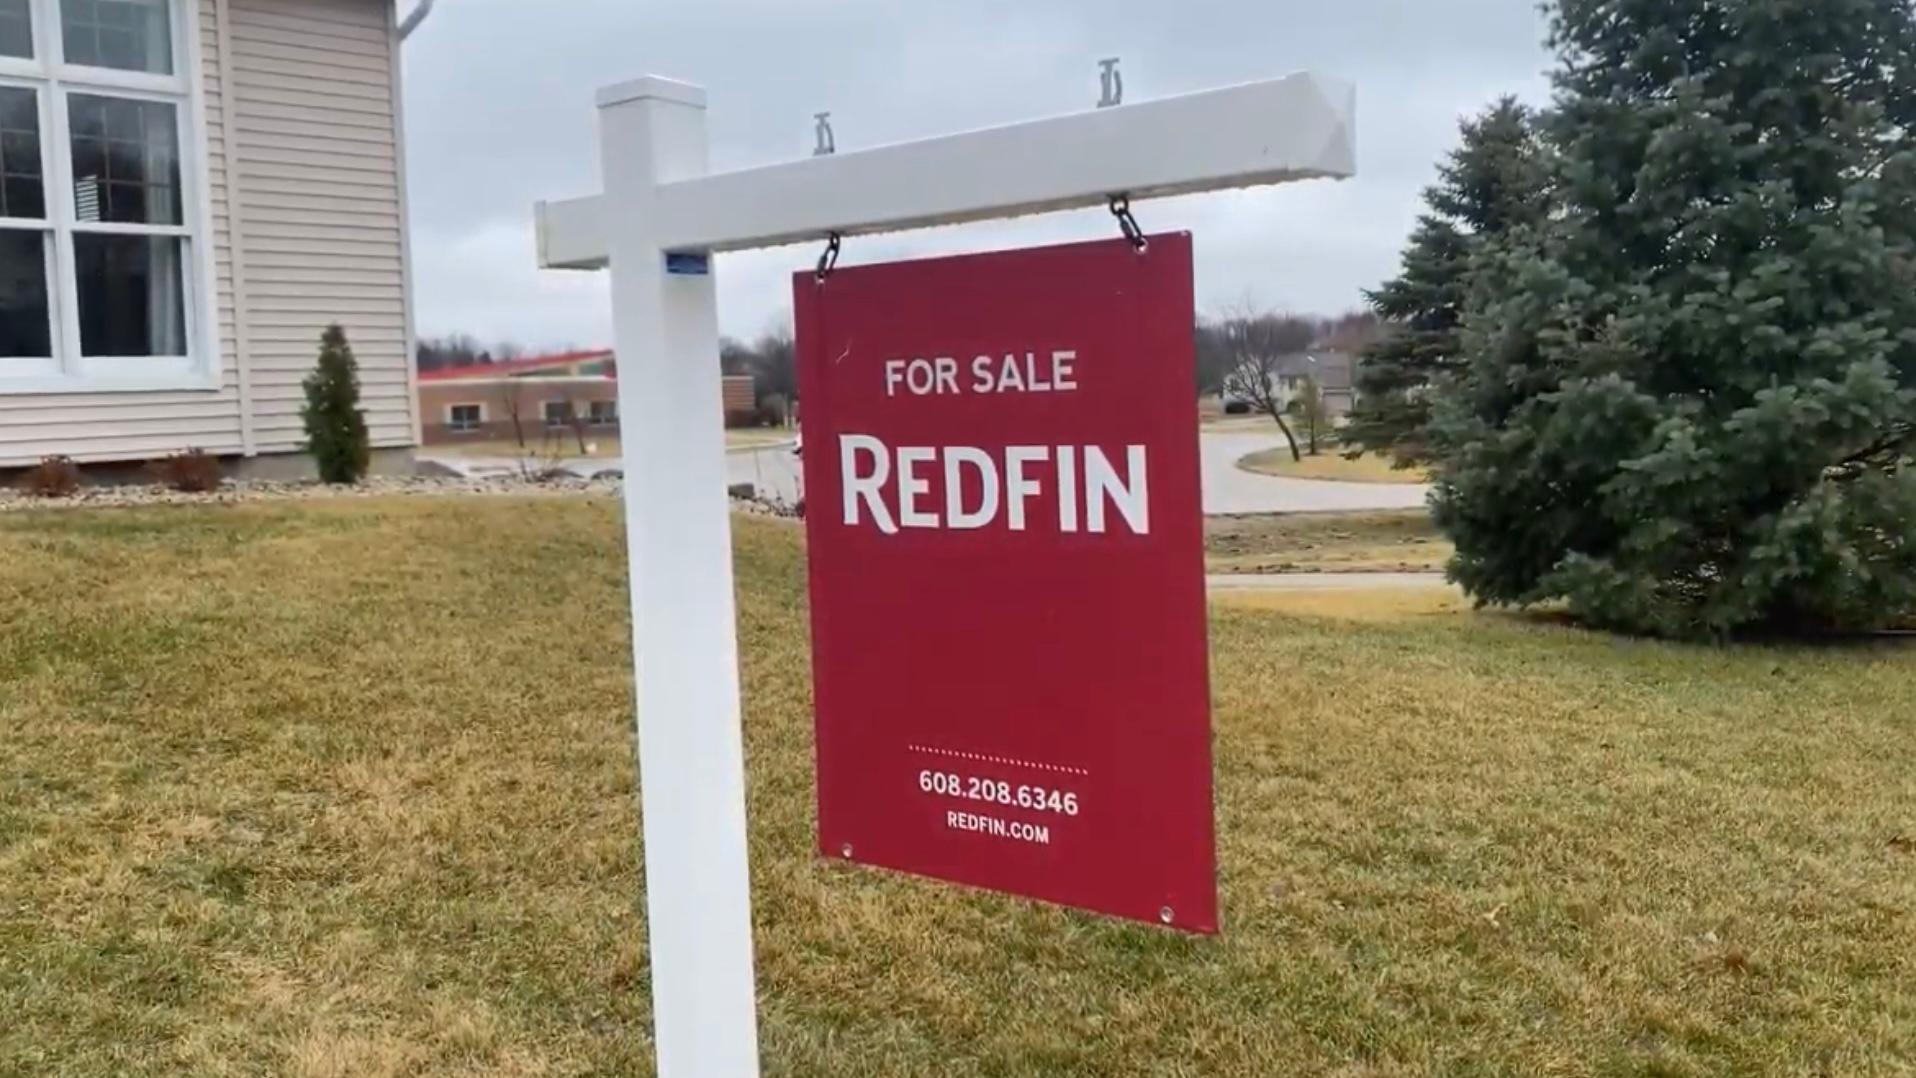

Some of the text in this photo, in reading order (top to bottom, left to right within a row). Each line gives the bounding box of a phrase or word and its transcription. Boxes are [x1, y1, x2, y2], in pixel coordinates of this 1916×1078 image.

[885, 350, 1078, 396] FOR SALE
[839, 434, 1150, 536] REDFIN
[919, 770, 1079, 816] 608.208.6346
[947, 810, 1049, 844] REDFIN.COM
